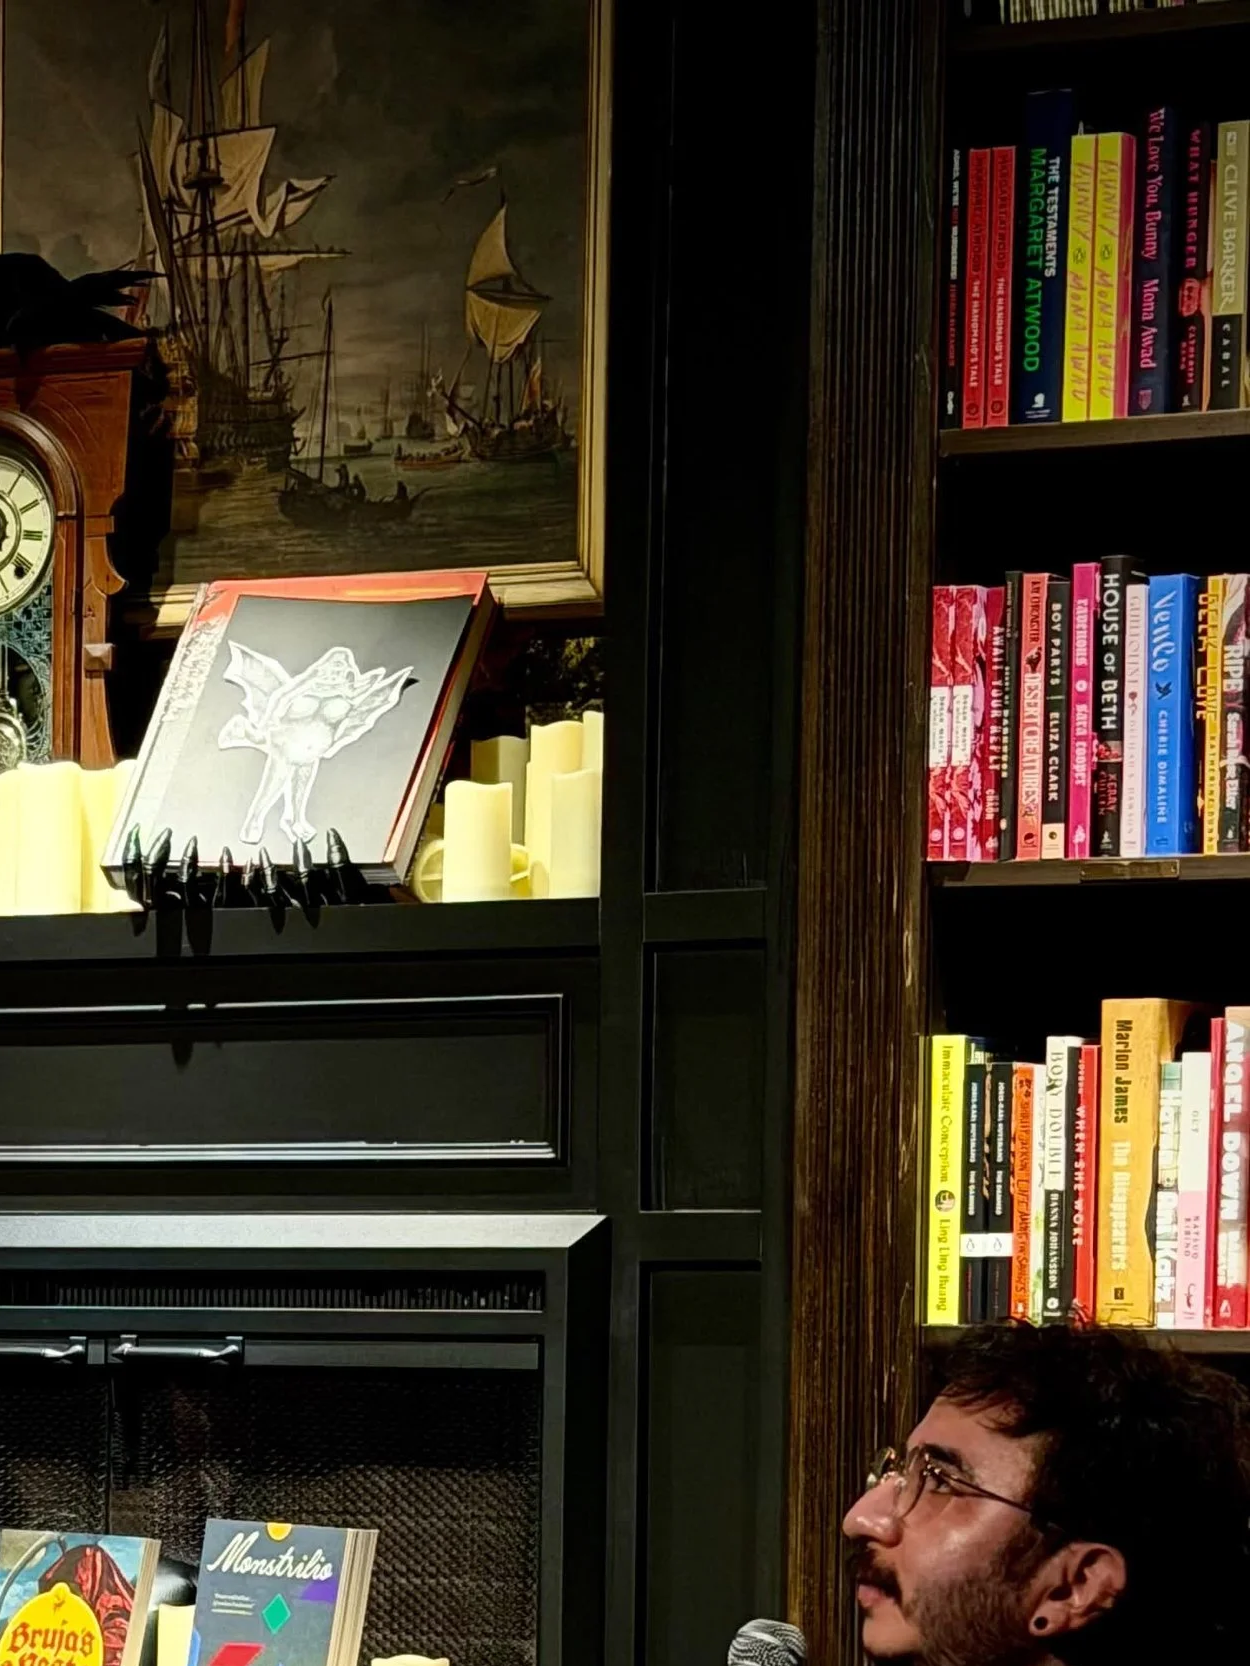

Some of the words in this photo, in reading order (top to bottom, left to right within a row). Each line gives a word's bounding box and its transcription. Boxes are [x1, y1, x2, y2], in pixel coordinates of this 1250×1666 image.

[1148, 108, 1165, 133] We
[1048, 157, 1060, 183] THE
[1148, 136, 1164, 171] Love
[1188, 129, 1200, 183] WHAT
[1027, 148, 1045, 266] MARGARET
[1100, 160, 1119, 238] BUNNY
[1146, 175, 1163, 207] You,
[1223, 164, 1237, 221] CLIVE
[1045, 189, 1059, 276] TESTAMENTS
[1141, 211, 1162, 259] Bunny
[1185, 192, 1198, 268] HUNGER
[972, 280, 981, 298] THE
[1219, 228, 1237, 312] BARKER
[1095, 268, 1114, 329] MONA
[1141, 279, 1158, 320] Mona
[970, 301, 981, 363] HANDMAID'S
[1023, 278, 1042, 371] ATWOOD
[1140, 326, 1157, 369] Awad
[969, 365, 979, 387] TALE
[1221, 323, 1231, 387] CABAL
[1050, 603, 1061, 633] BOY
[1102, 574, 1120, 644] HOUSE
[1151, 590, 1177, 672] VenCo
[1049, 639, 1061, 685] PARTS
[1023, 673, 1041, 725] DESERT
[1075, 704, 1089, 735] sara
[1100, 680, 1119, 729] BETH
[1049, 712, 1060, 751] ELIZA
[1157, 710, 1169, 755] CHERIE
[1021, 727, 1040, 804] CREATURES
[1048, 757, 1059, 801] CLARK
[1072, 742, 1087, 785] cooper
[1106, 773, 1117, 813] KERRY
[1156, 762, 1168, 823] DIMALINE
[1115, 1019, 1132, 1070] Marlon
[939, 1045, 954, 1111] Immaculate
[1223, 1020, 1244, 1121] ANGEL
[1114, 1076, 1132, 1123] James
[938, 1116, 953, 1182] Conception
[1112, 1141, 1131, 1166] The
[1073, 1160, 1085, 1191] SHE
[1220, 1132, 1241, 1220] DOWN
[938, 1219, 951, 1243] Ling
[1072, 1199, 1084, 1246] WOKE
[1109, 1171, 1130, 1270] Disappearers
[937, 1247, 951, 1271] Ling
[937, 1275, 951, 1310] Huang
[206, 1530, 333, 1580] Monstrilio
